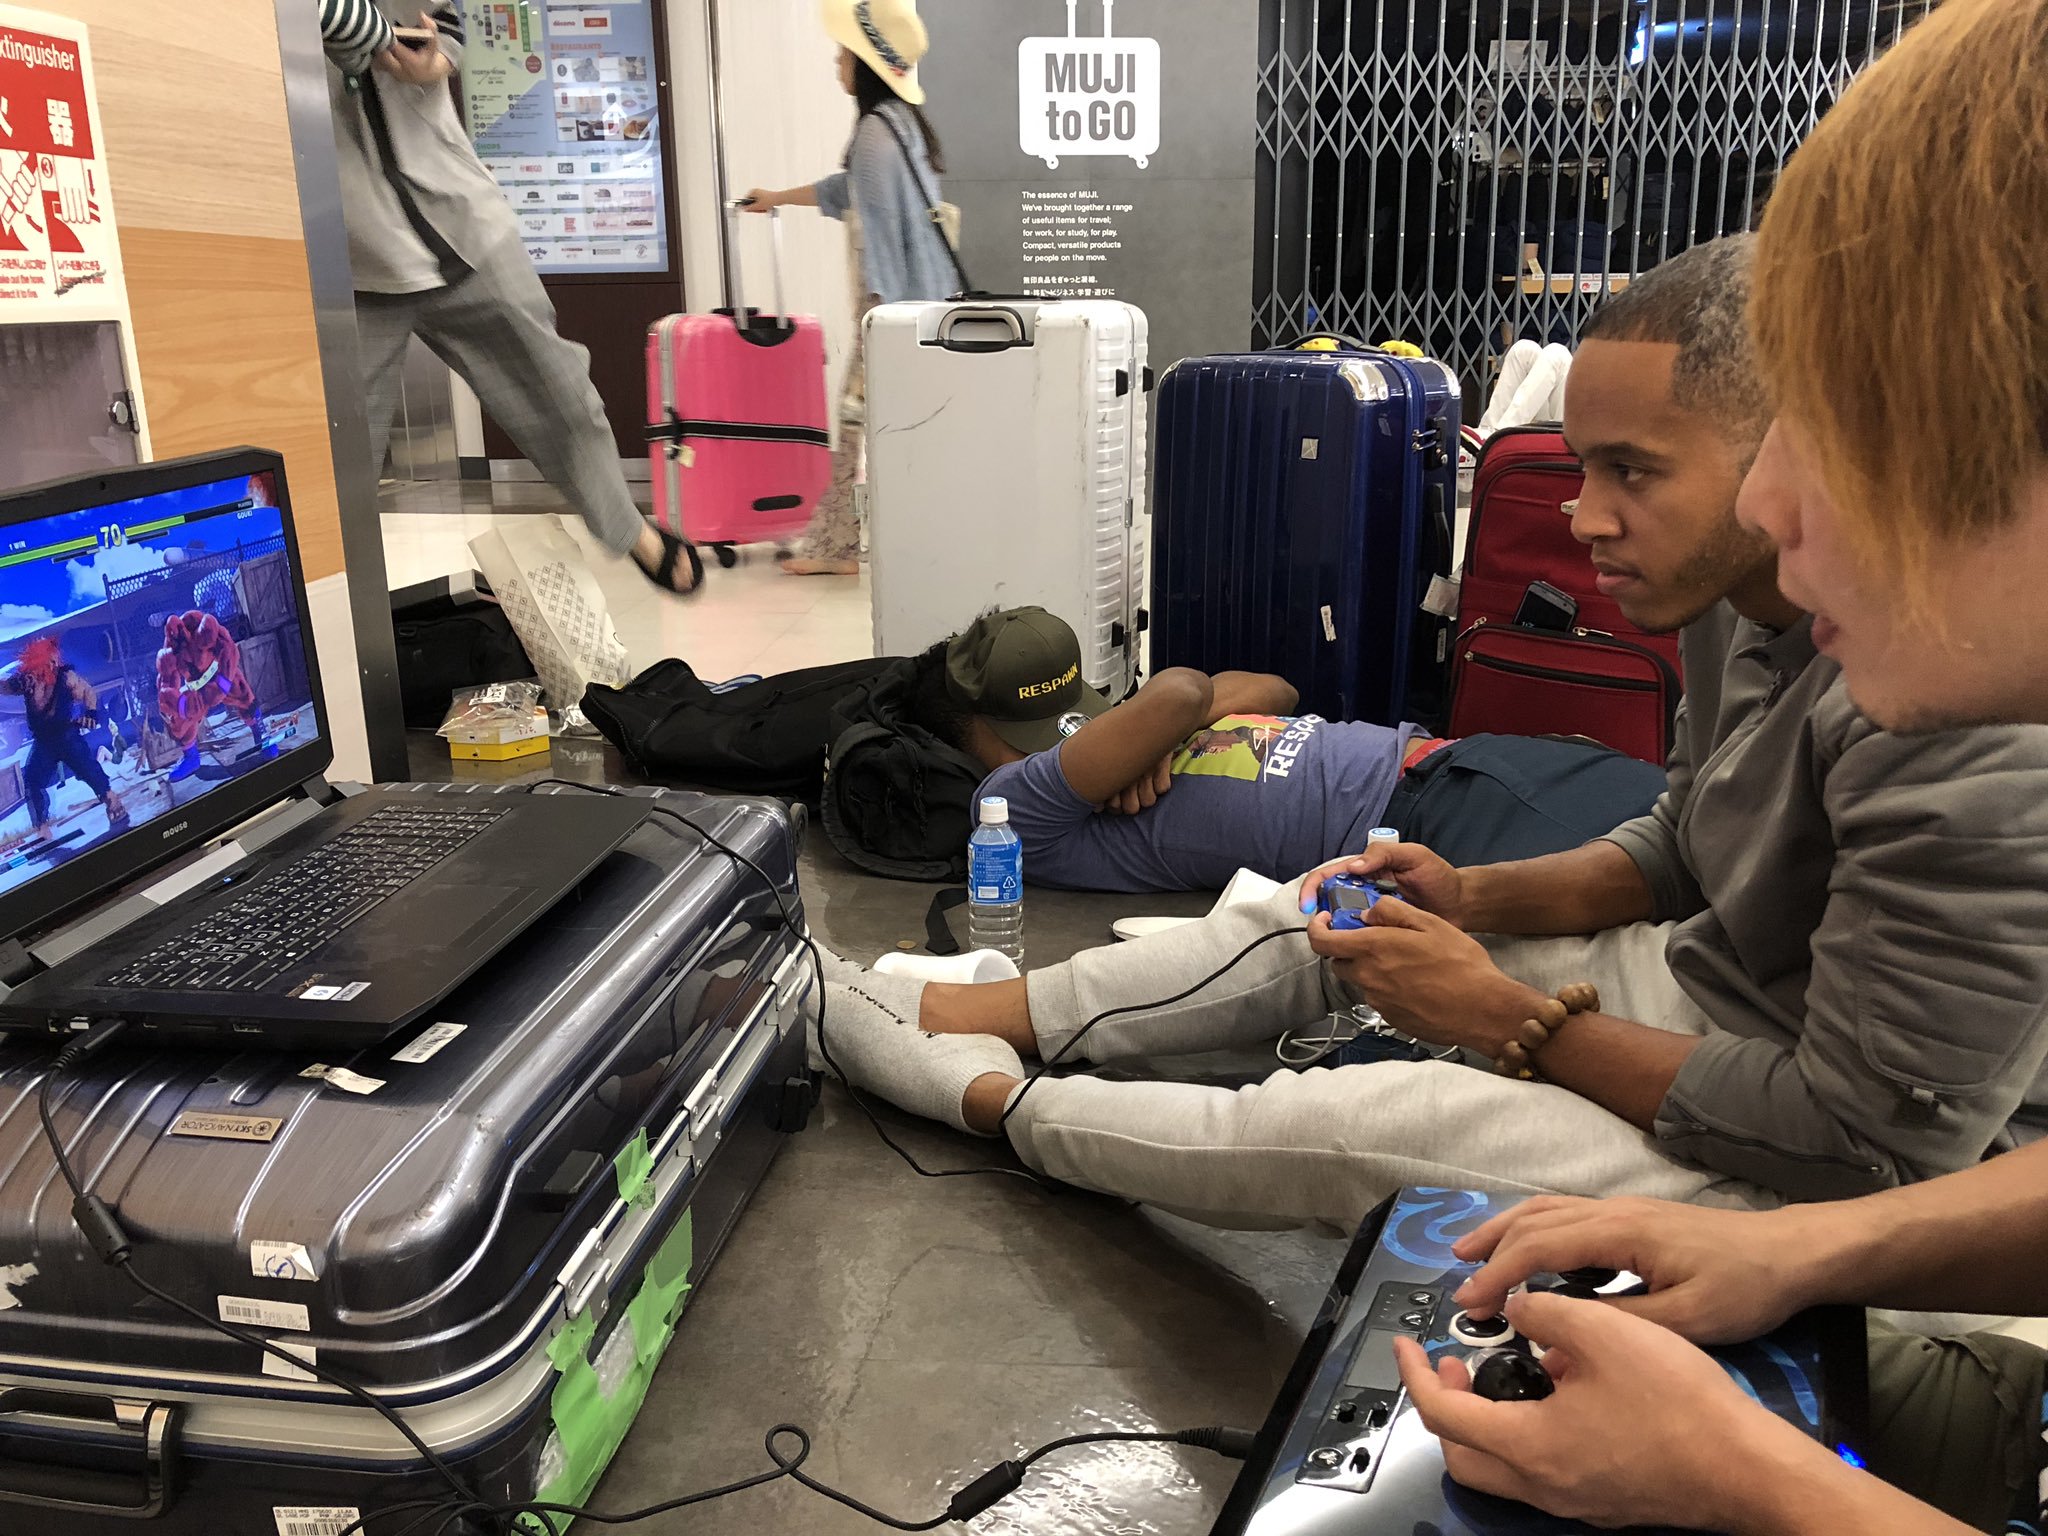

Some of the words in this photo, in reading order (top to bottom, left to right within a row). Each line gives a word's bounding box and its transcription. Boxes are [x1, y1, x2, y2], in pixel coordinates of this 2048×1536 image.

[1045, 53, 1136, 94] MUJI
[1045, 100, 1082, 141] to
[1088, 100, 1136, 141] GO
[1022, 191, 1036, 199] The
[1069, 191, 1077, 199] of
[1079, 191, 1098, 199] MUJI.
[1044, 204, 1072, 213] brought
[1074, 204, 1104, 213] together
[1032, 216, 1054, 224] useful
[1078, 216, 1088, 224] for
[1090, 216, 1112, 224] travel;
[1023, 229, 1033, 237] for
[1035, 229, 1054, 237] work,
[1068, 229, 1089, 238] study,
[1102, 229, 1117, 237] play.
[1023, 242, 1056, 250] Compact,
[1058, 241, 1088, 249] versatile
[1090, 241, 1122, 250] products
[1023, 254, 1033, 262] for
[1035, 254, 1059, 263] people
[100, 523, 122, 549] 70
[1018, 662, 1078, 700] RESPAWN
[162, 820, 189, 840] mouse
